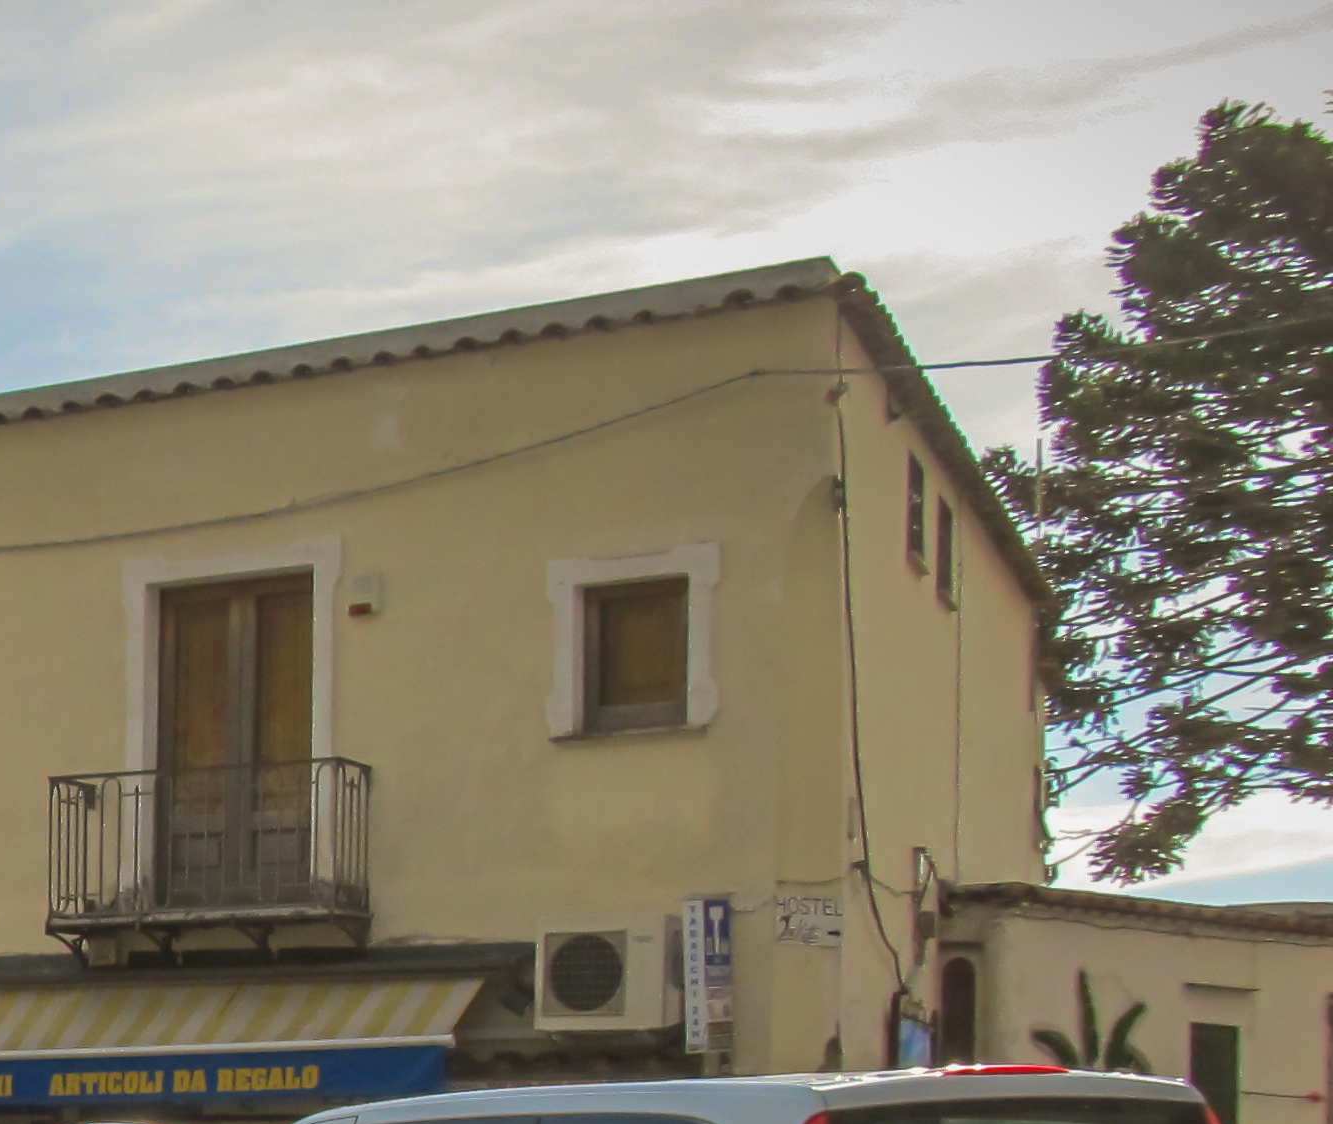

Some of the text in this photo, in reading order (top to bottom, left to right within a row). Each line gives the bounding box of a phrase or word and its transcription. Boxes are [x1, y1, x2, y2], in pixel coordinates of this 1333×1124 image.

[776, 895, 844, 917] HOSTEL
[48, 1070, 165, 1097] ARTICOLI
[172, 1068, 208, 1094] DA
[216, 1065, 320, 1093] REGALO
